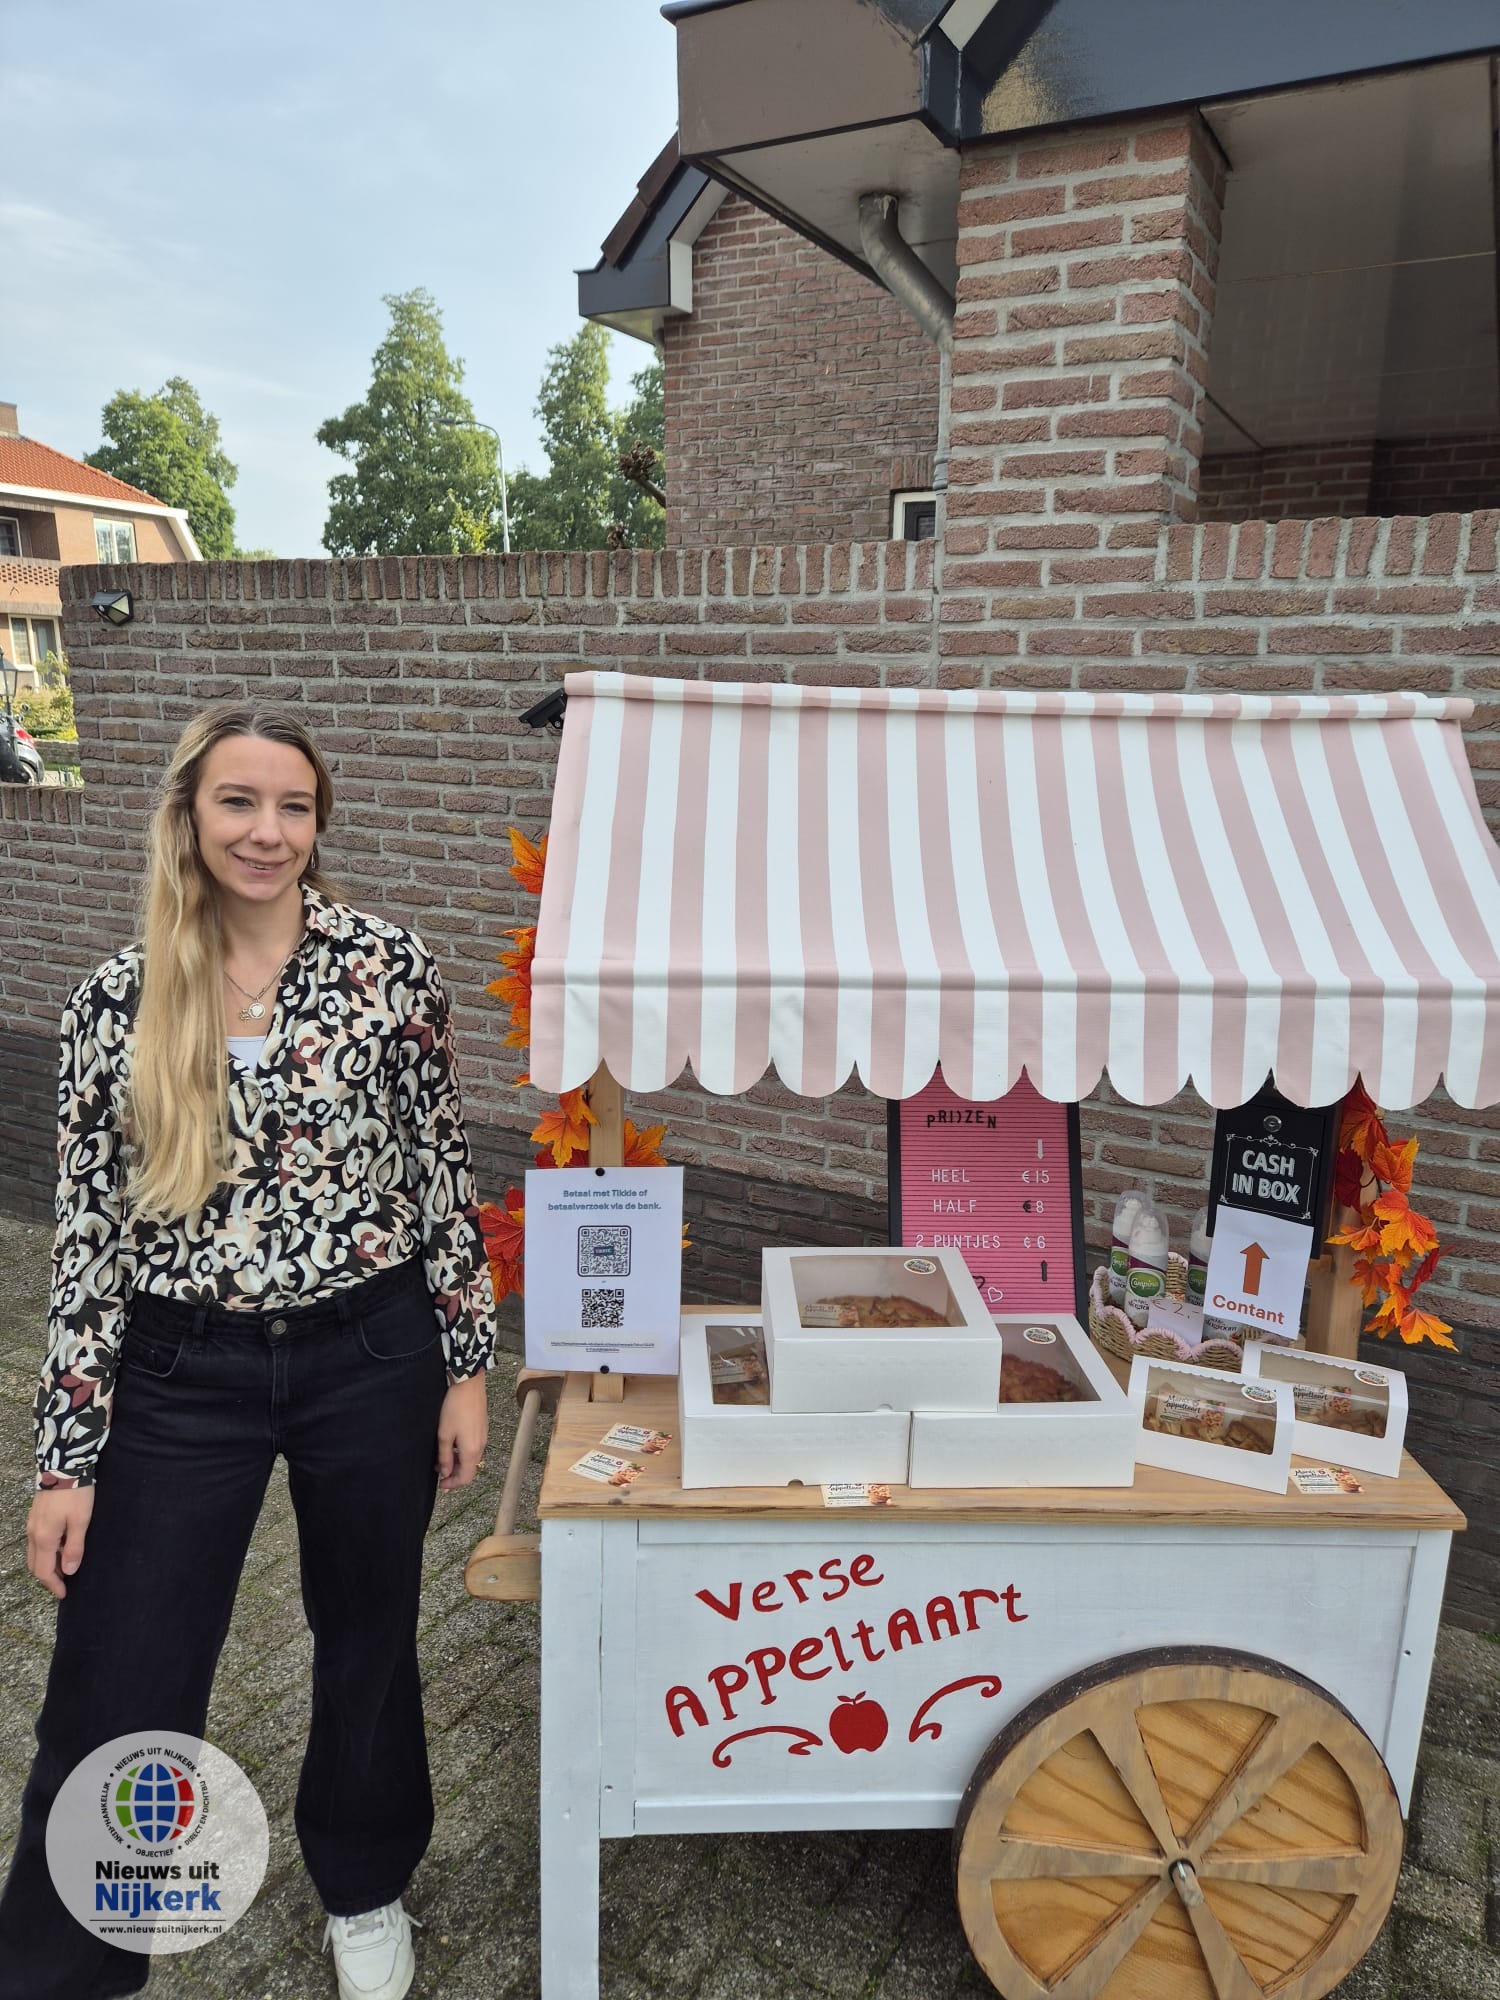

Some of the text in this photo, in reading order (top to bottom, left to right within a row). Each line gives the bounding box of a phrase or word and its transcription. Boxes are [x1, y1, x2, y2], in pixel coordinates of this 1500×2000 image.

[1242, 1150, 1296, 1178] CASH
[931, 1169, 970, 1183] HEEL
[563, 1190, 591, 1198] Betaal
[612, 1189, 637, 1197] Tikkie
[639, 1189, 648, 1197] of
[1232, 1173, 1301, 1205] IN BOX
[625, 1202, 636, 1210] de
[933, 1200, 977, 1213] HALF
[915, 1234, 925, 1248] 2
[933, 1234, 1001, 1249] PUNTJES
[1212, 1294, 1286, 1325] Contant
